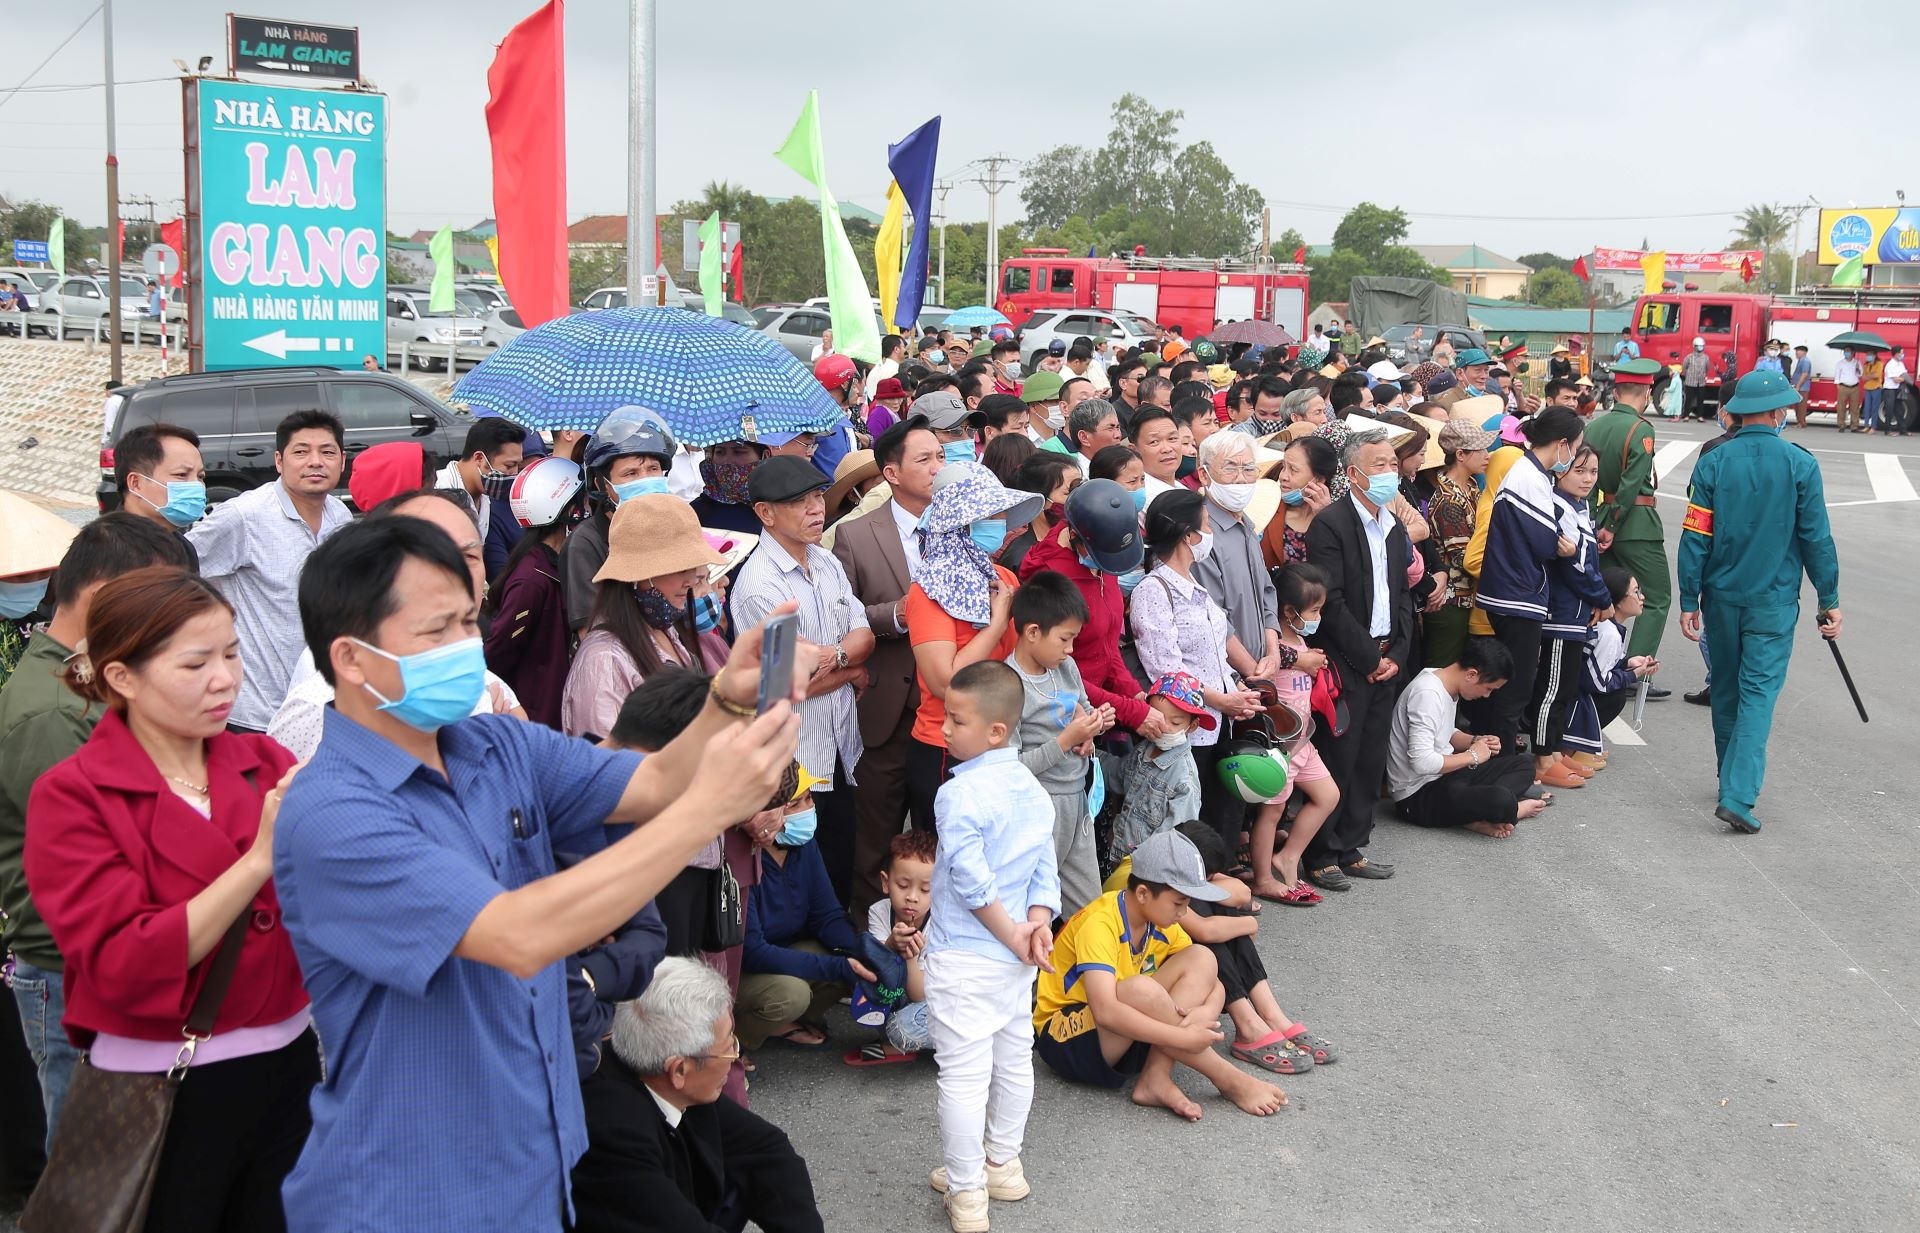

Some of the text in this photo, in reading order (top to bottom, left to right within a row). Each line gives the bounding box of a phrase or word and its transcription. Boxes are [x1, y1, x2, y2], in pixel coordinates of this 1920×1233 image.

[264, 26, 328, 43] NHÀ HÀNG
[239, 39, 352, 66] LAM GIANG
[214, 96, 375, 135] NHÀ HÀNG
[245, 142, 356, 210] LAM
[209, 222, 380, 288] GIANG
[213, 293, 379, 321] NHÀ HÀNG VĂN MINH
